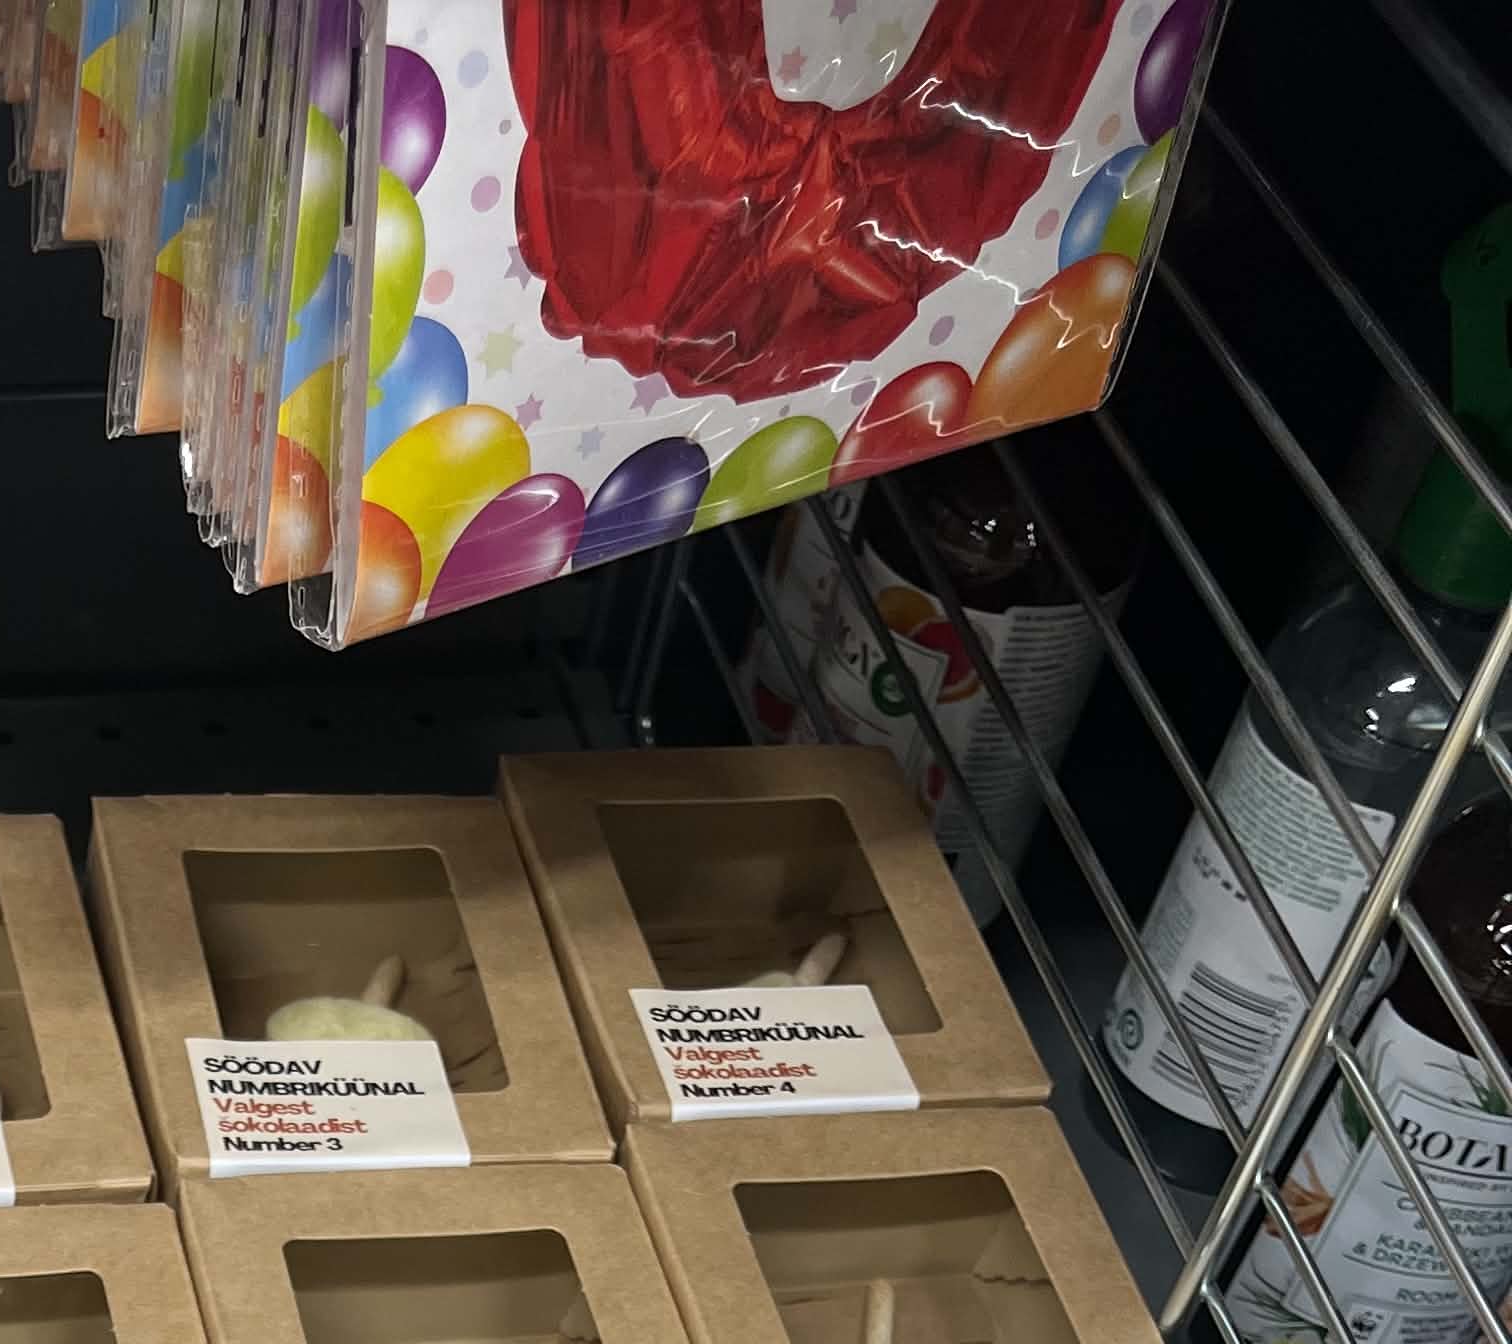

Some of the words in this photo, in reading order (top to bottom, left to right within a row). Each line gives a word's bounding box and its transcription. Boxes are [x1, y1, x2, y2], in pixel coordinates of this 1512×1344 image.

[648, 1005, 763, 1024] SÖÖDAV
[655, 1022, 866, 1044] NUMBRIKÜÜNAL
[663, 1045, 764, 1064] Valgest
[203, 1054, 322, 1076] SÖÖDAV
[673, 1062, 818, 1080] šokolaadist
[207, 1077, 426, 1097] NUMBRIKÜÜNAL
[679, 1082, 777, 1098] Number
[779, 1080, 797, 1094] 4
[212, 1097, 316, 1118] Valgest
[218, 1115, 369, 1134] šokolaadist
[221, 1136, 323, 1152] Number
[325, 1137, 344, 1151] 3
